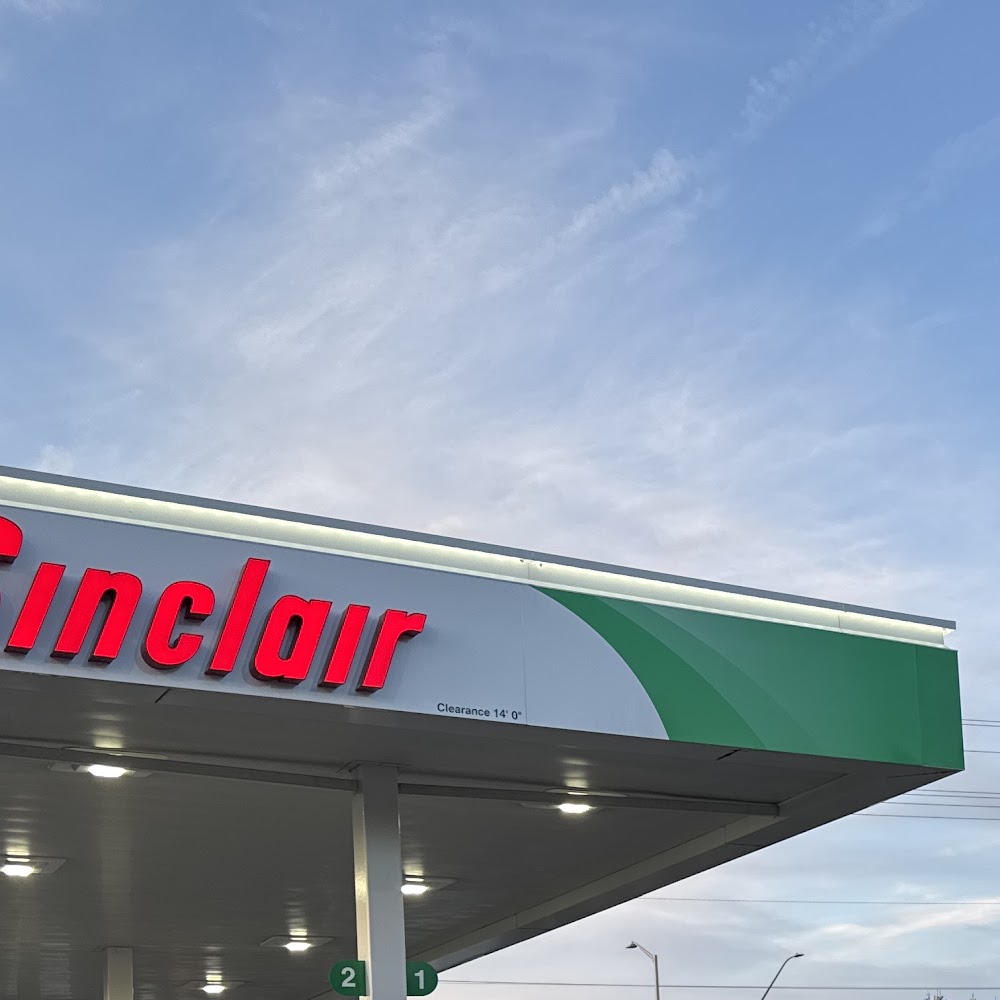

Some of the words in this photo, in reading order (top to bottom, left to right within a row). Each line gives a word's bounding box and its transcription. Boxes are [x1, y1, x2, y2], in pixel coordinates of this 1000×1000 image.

[437, 703, 490, 717] Clearance
[494, 709, 508, 719] 14'
[341, 967, 356, 988] 2
[413, 970, 425, 989] 1
